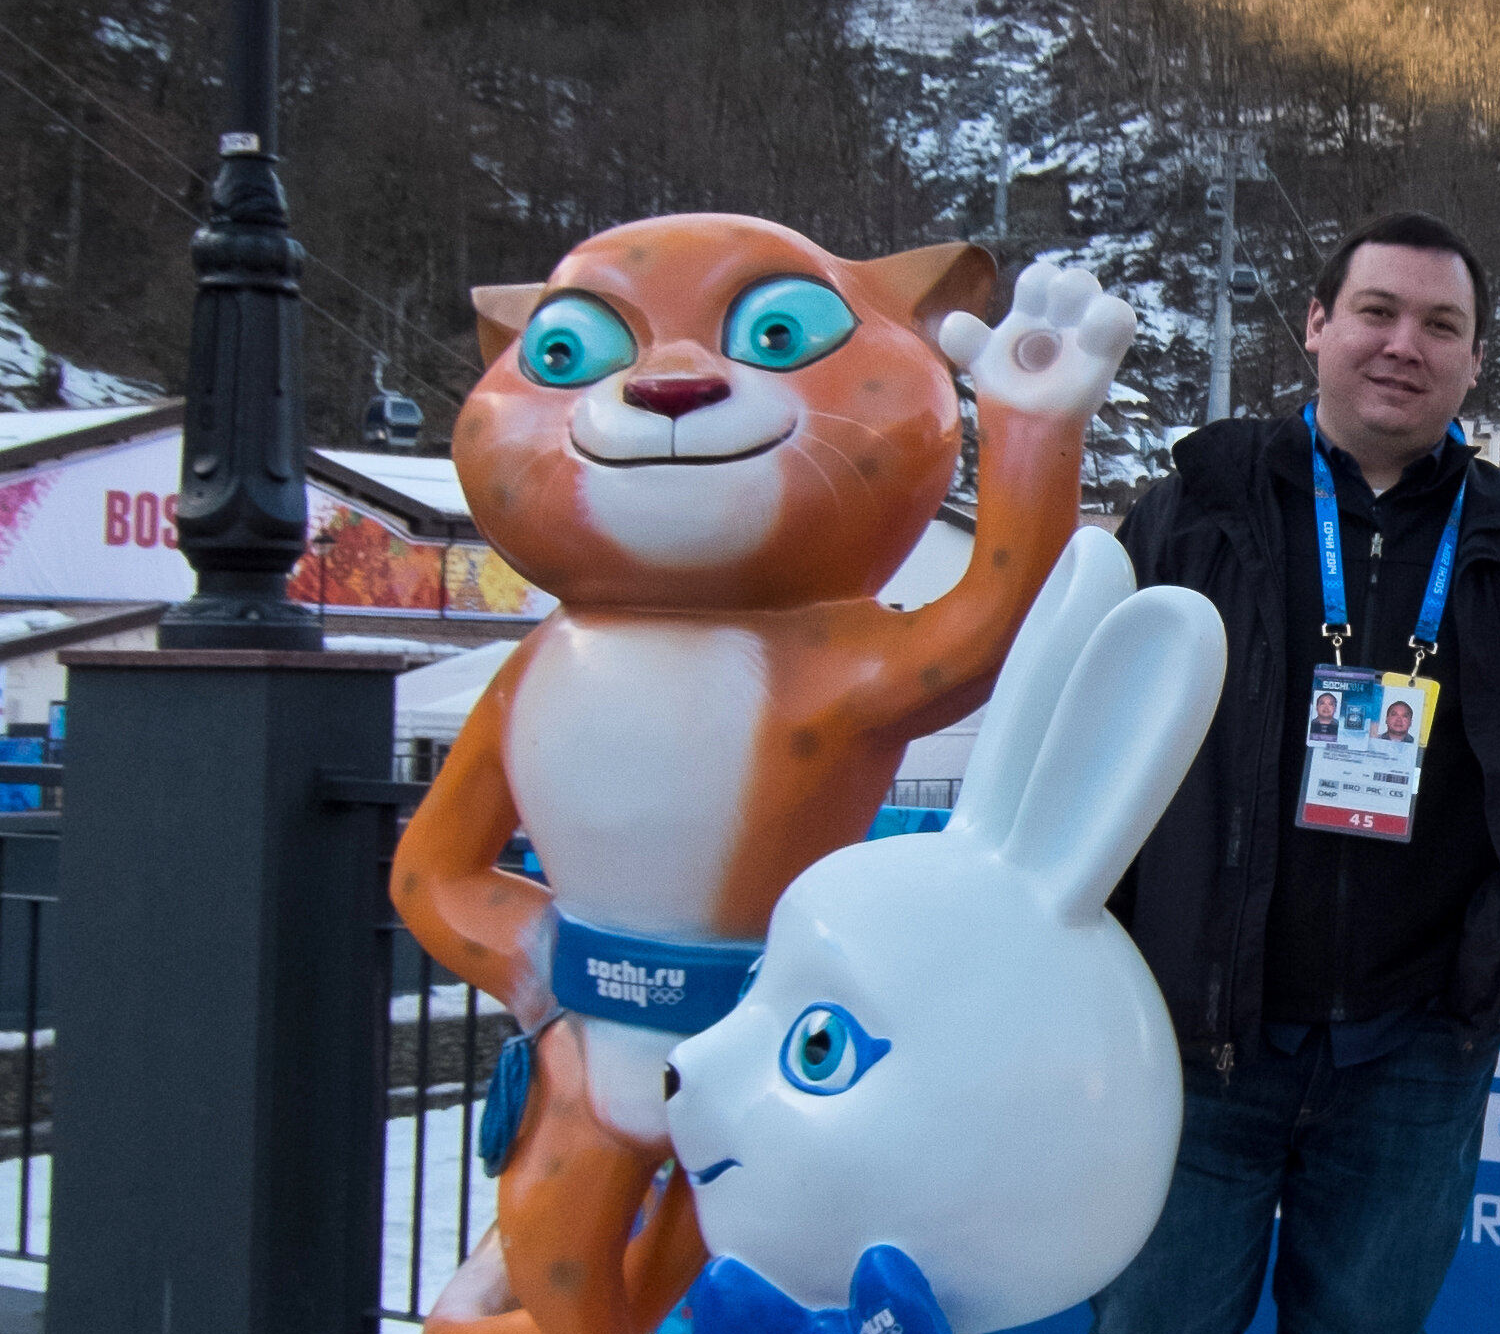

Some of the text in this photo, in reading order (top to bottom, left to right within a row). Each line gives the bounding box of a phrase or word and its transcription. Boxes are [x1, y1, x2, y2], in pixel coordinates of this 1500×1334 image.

[1326, 551, 1337, 575] 2014
[1433, 565, 1448, 596] SOCHI
[587, 958, 685, 987] sochi.ru
[597, 979, 647, 1007] 2014
